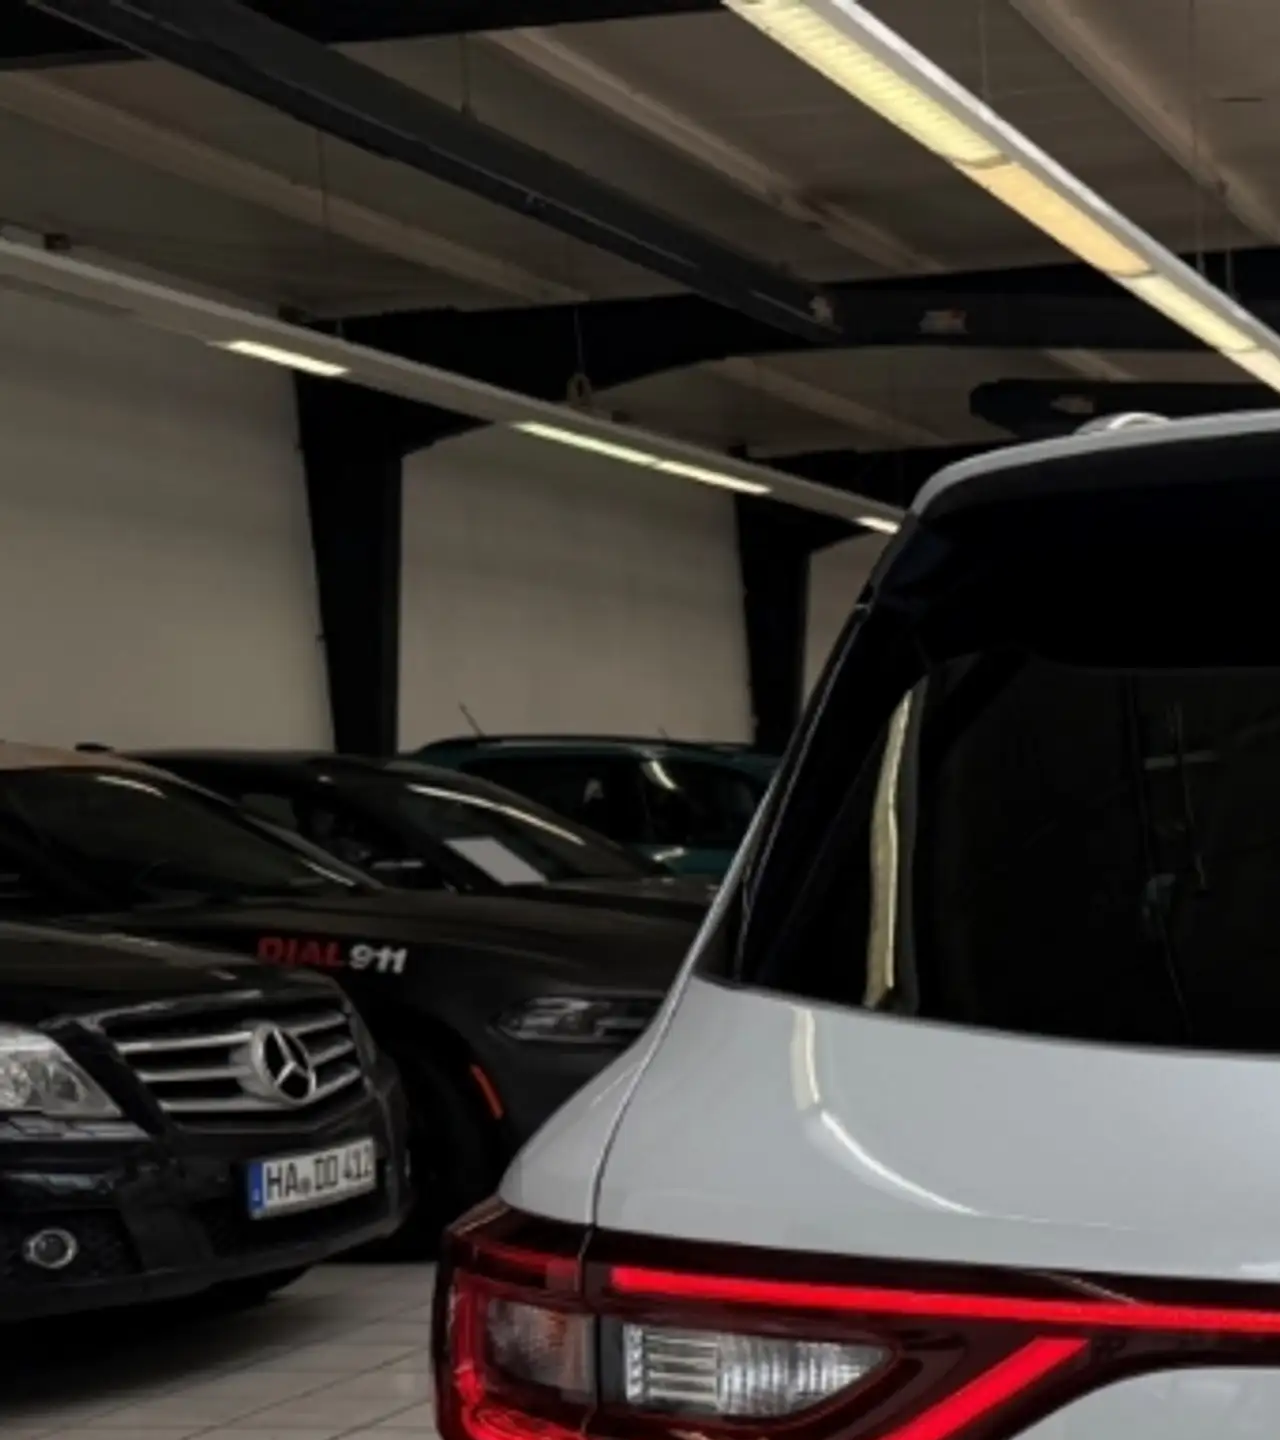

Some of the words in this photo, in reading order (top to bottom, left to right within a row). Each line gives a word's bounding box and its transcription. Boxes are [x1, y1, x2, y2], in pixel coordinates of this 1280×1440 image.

[258, 937, 344, 967] DIAL
[350, 943, 407, 973] 911
[265, 1161, 299, 1200] HA
